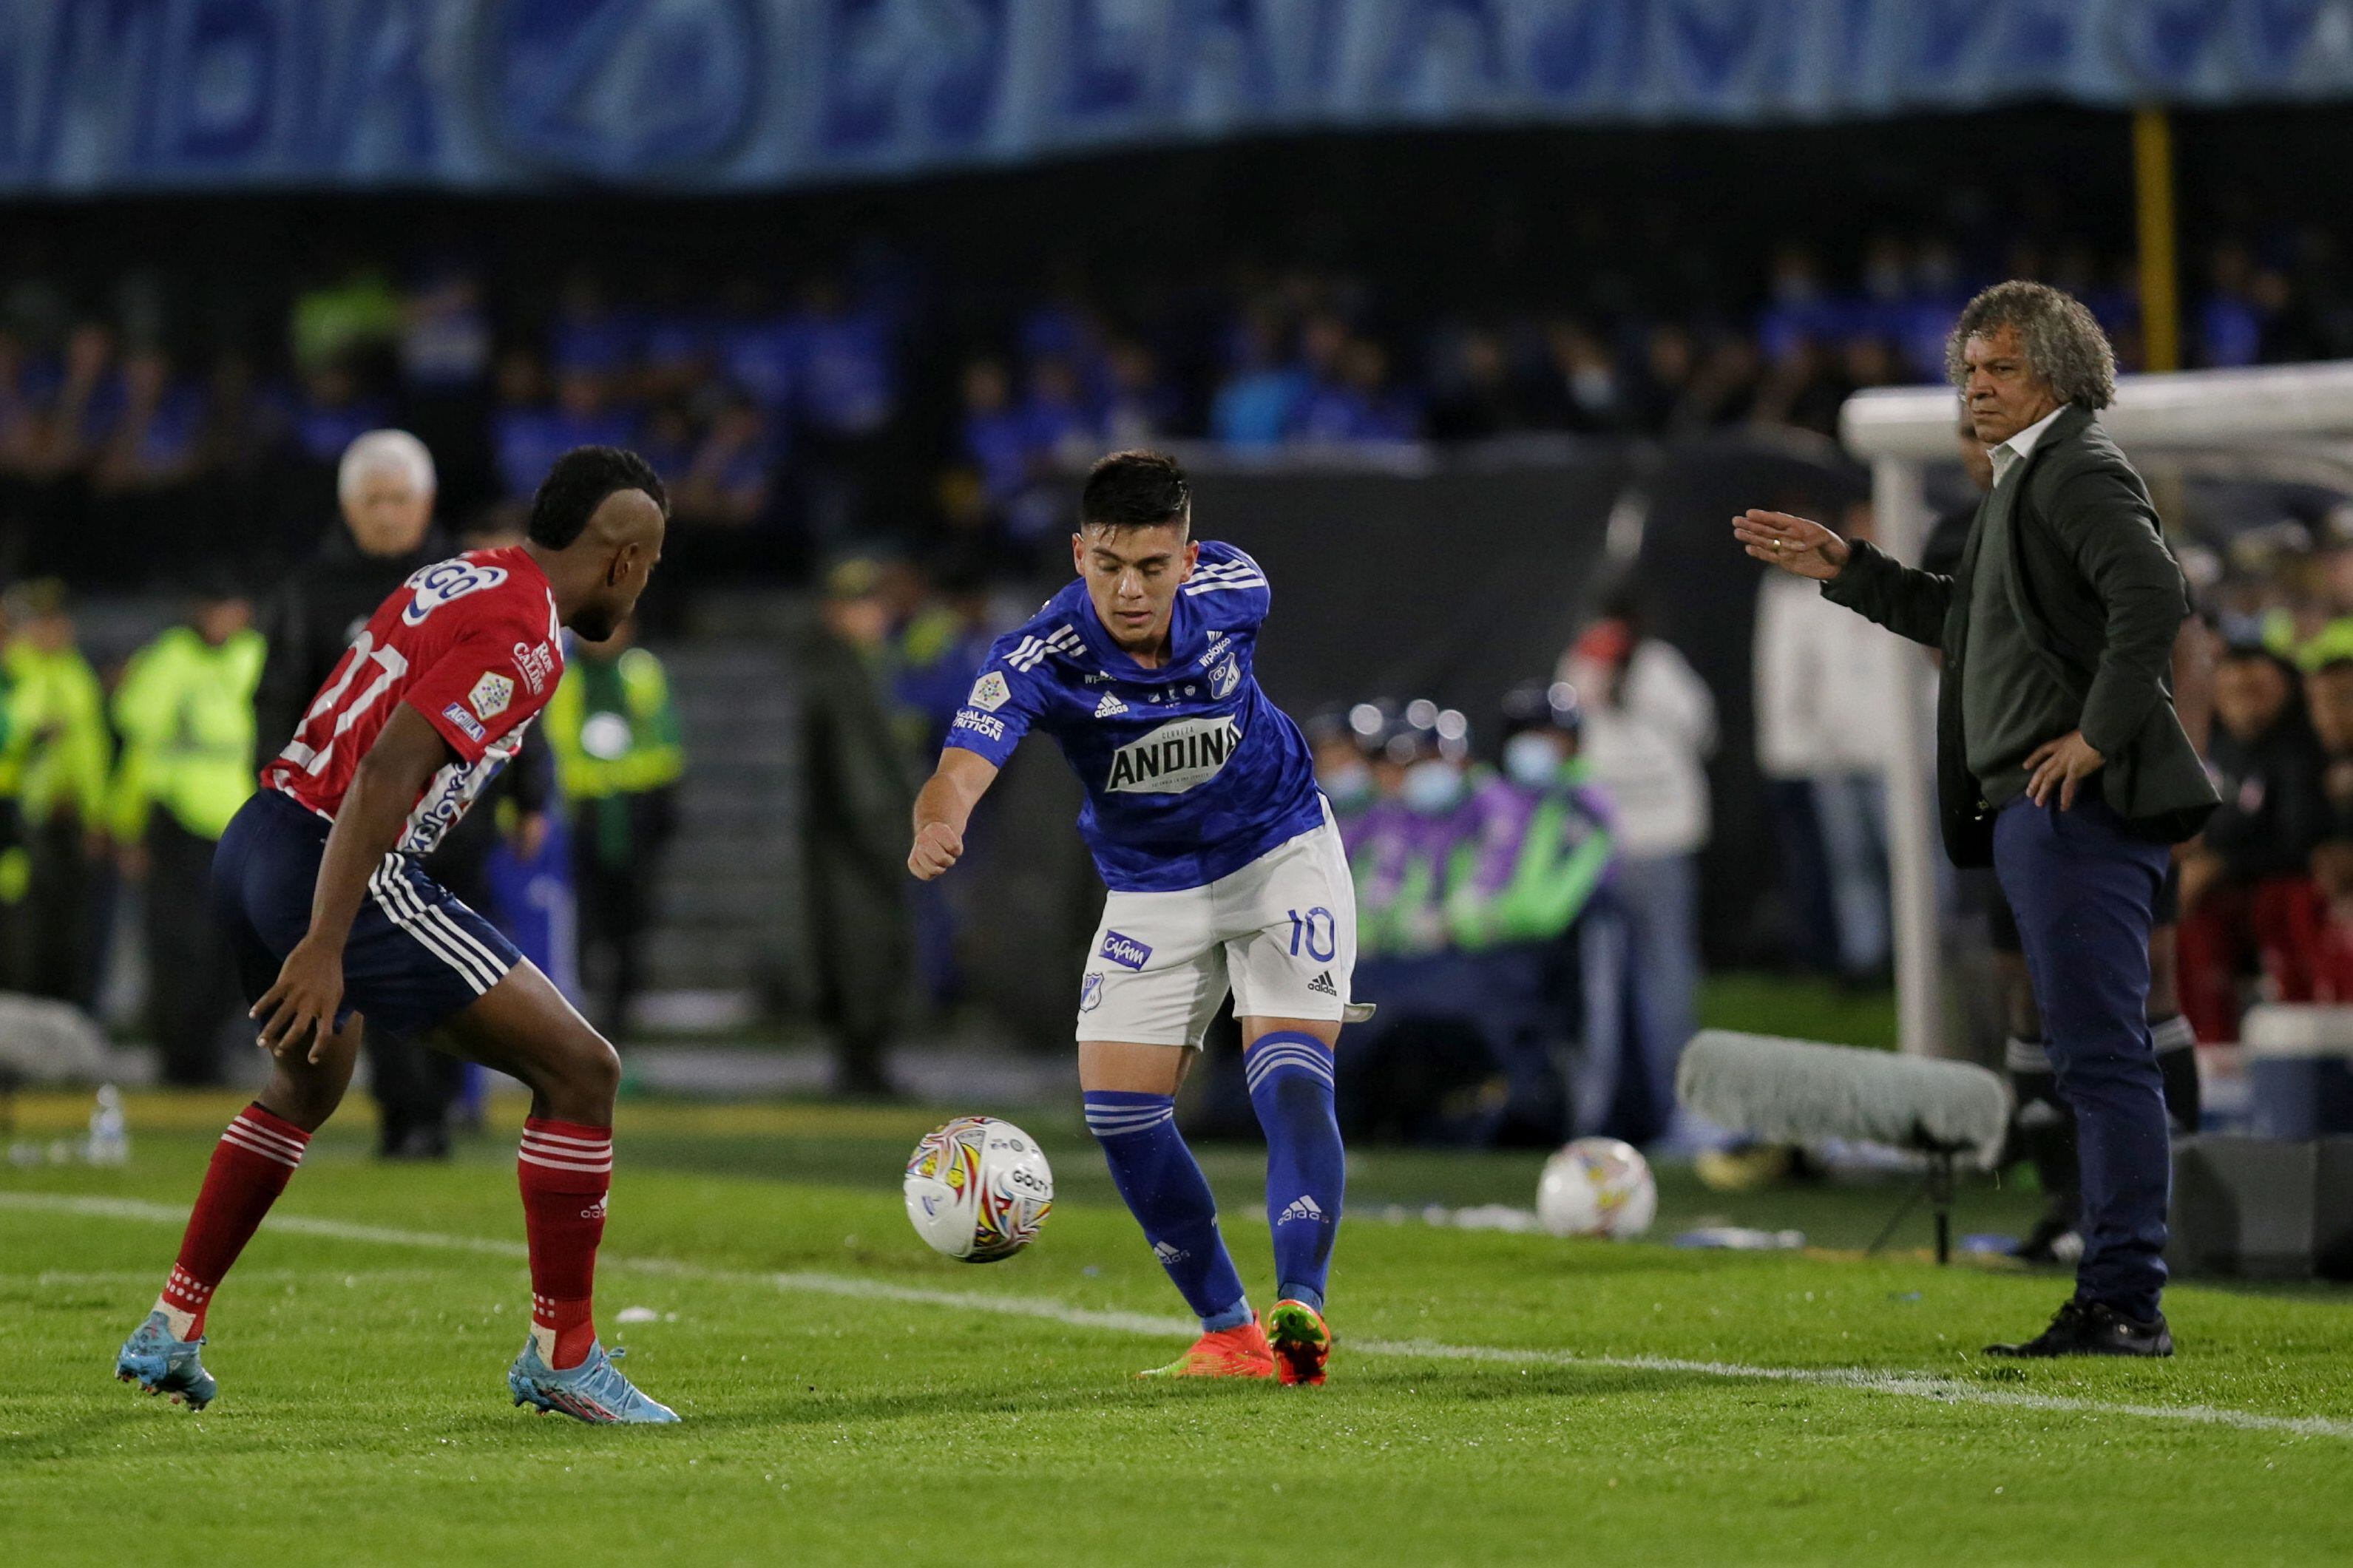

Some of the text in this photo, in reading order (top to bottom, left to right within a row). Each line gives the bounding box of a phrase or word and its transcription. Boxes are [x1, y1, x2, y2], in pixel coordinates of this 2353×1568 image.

[514, 642, 544, 696] CALDAS
[1094, 705, 1129, 719] adidas
[1287, 906, 1335, 962] 10
[1307, 982, 1337, 997] adidas
